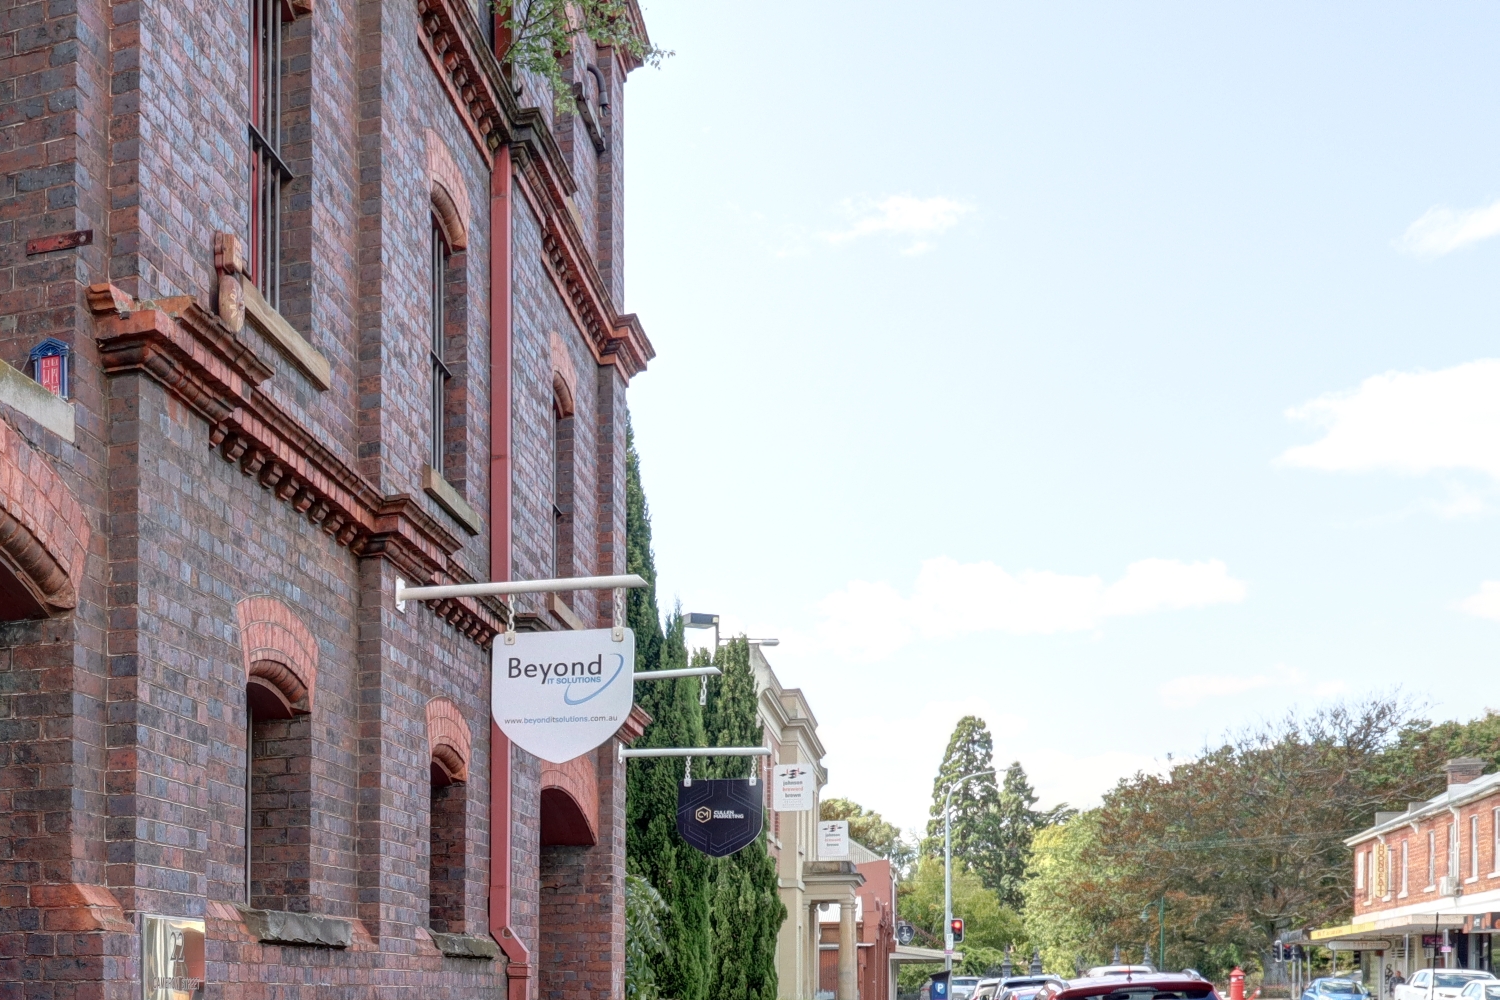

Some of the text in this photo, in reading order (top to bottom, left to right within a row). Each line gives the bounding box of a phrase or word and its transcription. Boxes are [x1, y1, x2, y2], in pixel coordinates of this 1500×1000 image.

[508, 653, 602, 685] Beyond
[547, 676, 602, 685] IT SOLUTIONS
[504, 715, 618, 725] www.beyonditsolutions.com.au
[170, 931, 184, 962] 22
